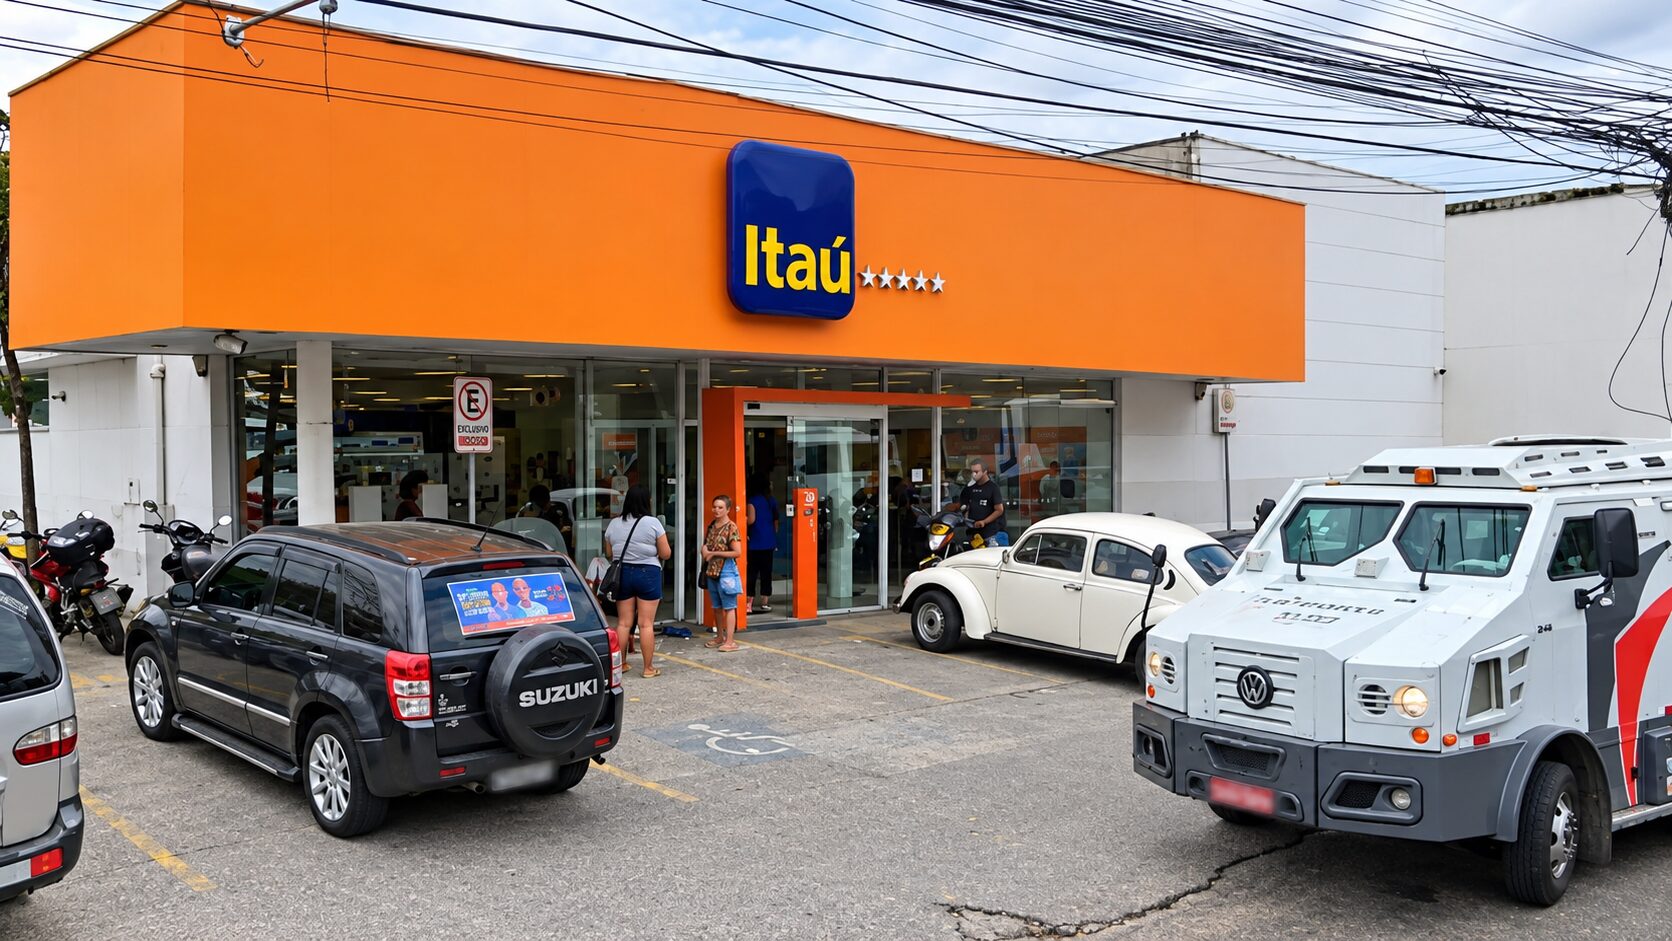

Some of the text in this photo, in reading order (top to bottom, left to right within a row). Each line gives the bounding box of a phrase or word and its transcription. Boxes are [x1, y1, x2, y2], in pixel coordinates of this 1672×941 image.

[745, 224, 851, 294] Itaú
[457, 424, 489, 433] EXCLUSIVO
[519, 678, 598, 708] SUZUKI
